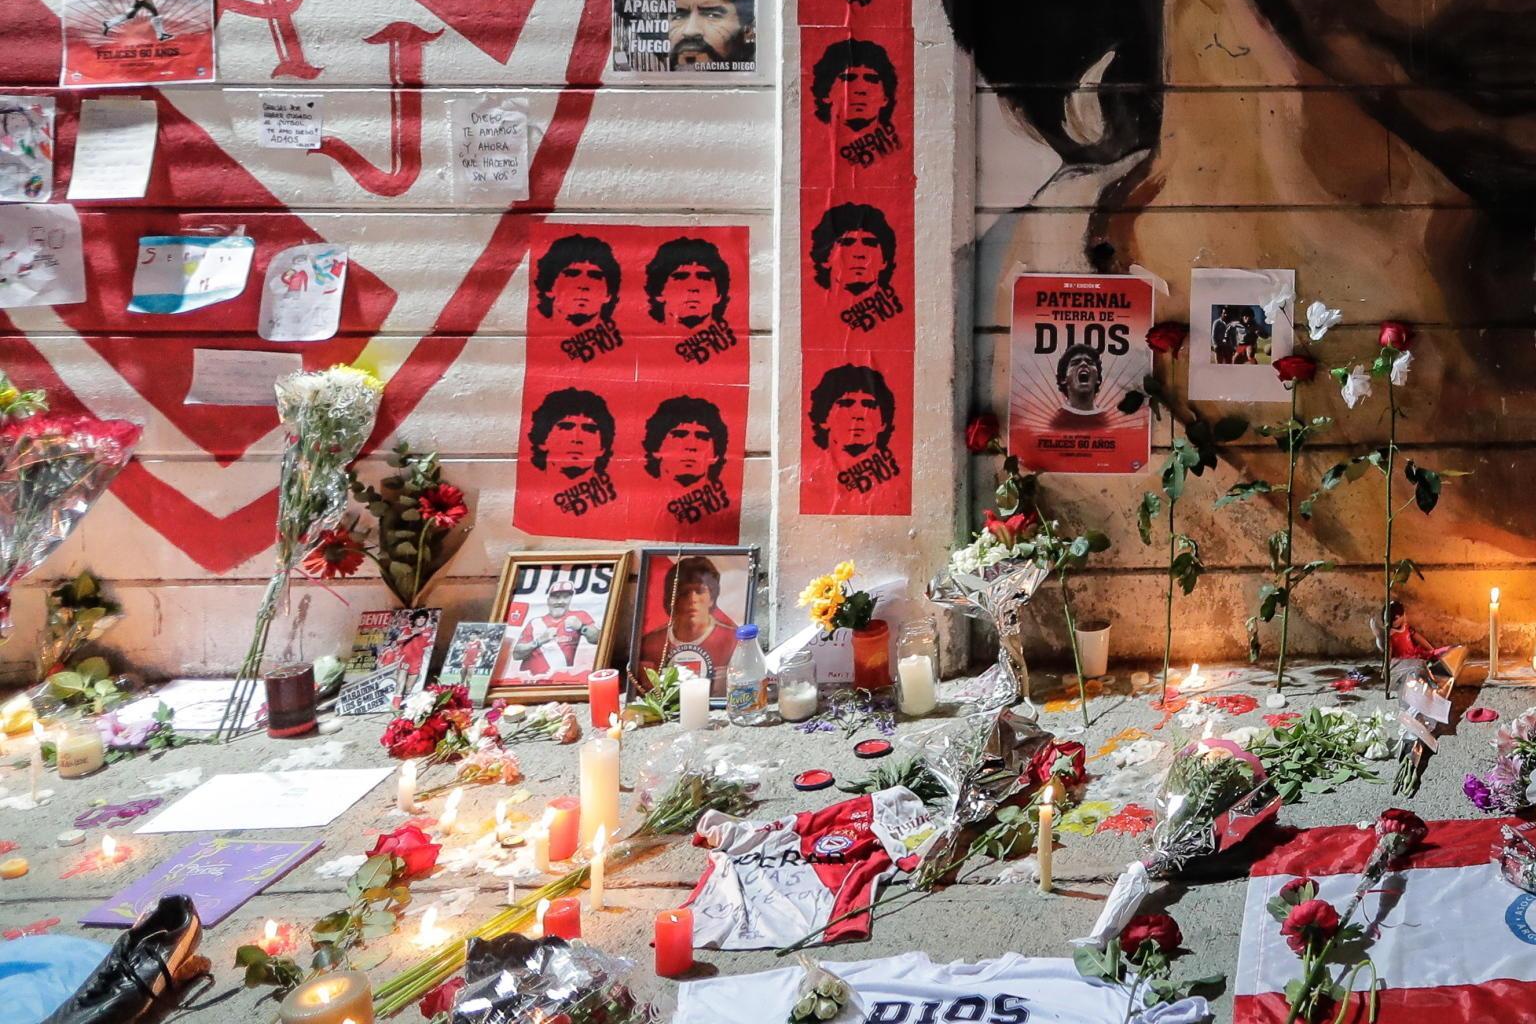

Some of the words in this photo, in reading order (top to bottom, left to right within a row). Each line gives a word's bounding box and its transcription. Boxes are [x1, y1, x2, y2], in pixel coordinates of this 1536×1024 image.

[623, 0, 677, 13] APAGAR
[629, 19, 669, 33] TANTO
[630, 39, 671, 53] FUEGO
[694, 61, 730, 71] GRACIAS
[732, 61, 755, 71] DIEGO
[463, 127, 474, 138] TE
[479, 124, 519, 136] AMAMOS
[463, 142, 472, 154] Y
[477, 142, 510, 152] AHORA
[1035, 291, 1131, 309] PATERNAL
[1052, 311, 1095, 321] TIERRA
[1099, 311, 1115, 321] DE
[1037, 438, 1075, 449] FELICES
[1092, 437, 1116, 449] AÑOS
